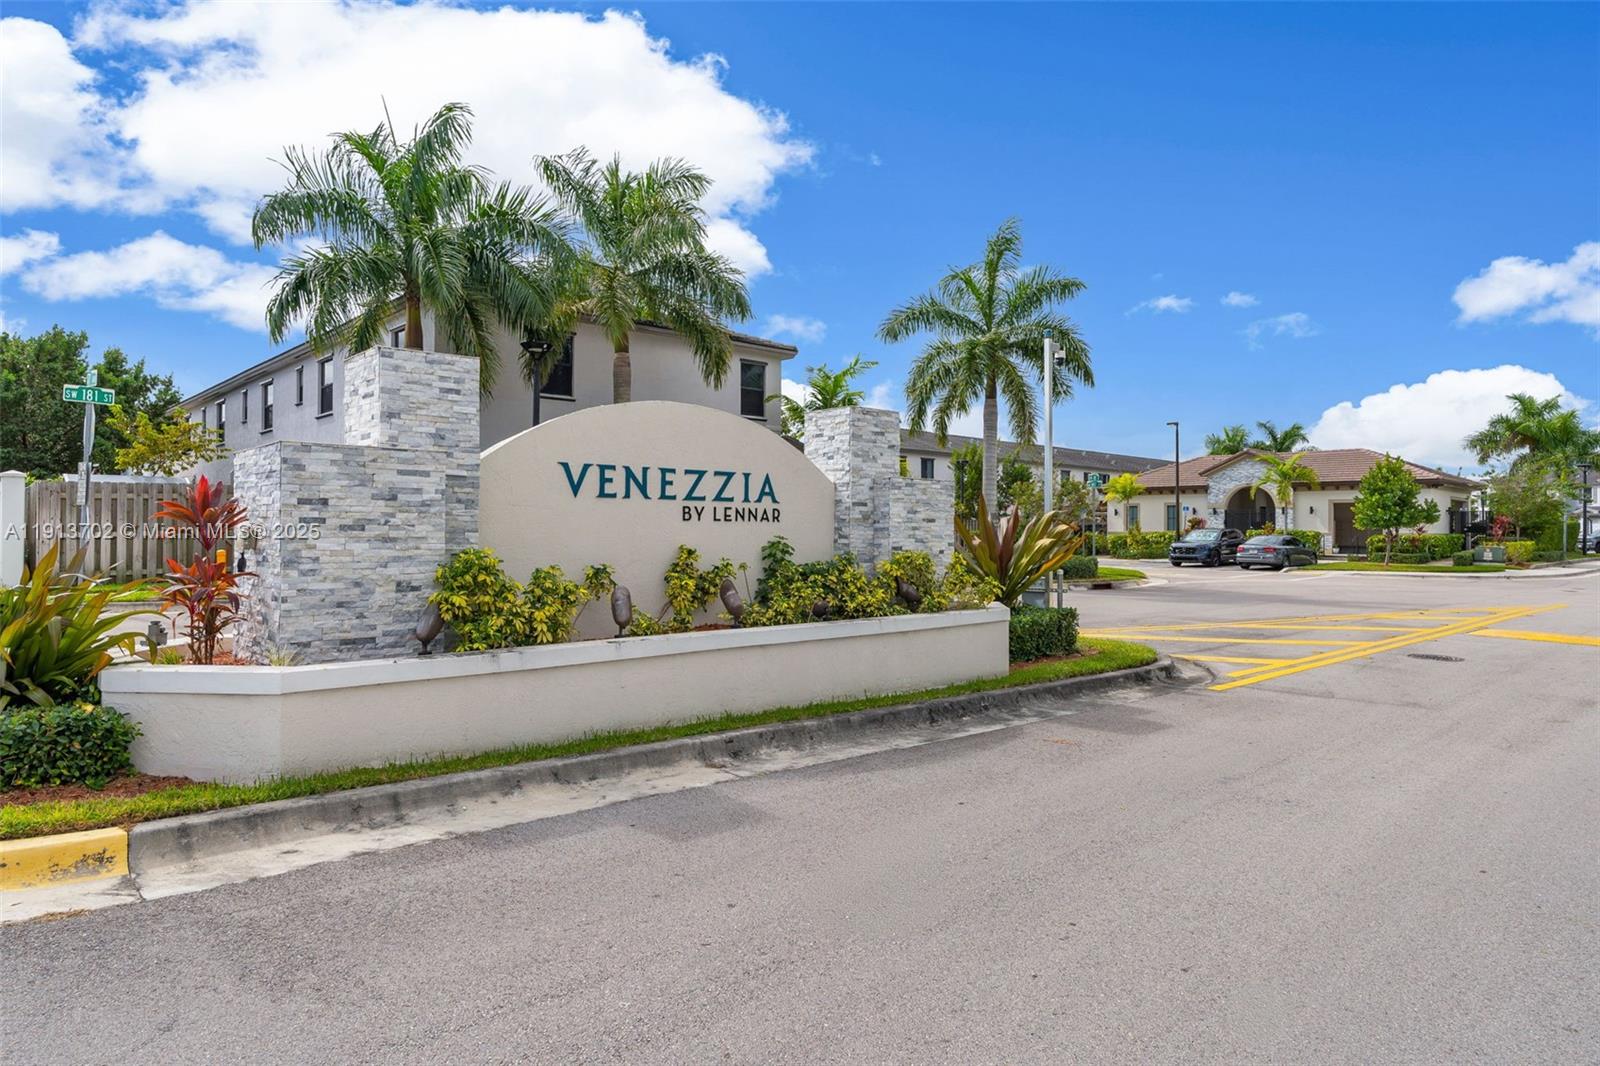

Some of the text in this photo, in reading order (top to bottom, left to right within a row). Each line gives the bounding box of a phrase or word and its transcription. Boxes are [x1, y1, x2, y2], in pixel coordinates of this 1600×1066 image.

[65, 389, 113, 402] SW 181 ST
[557, 461, 781, 504] VENEZZIA
[682, 506, 781, 523] BY LENNAR
